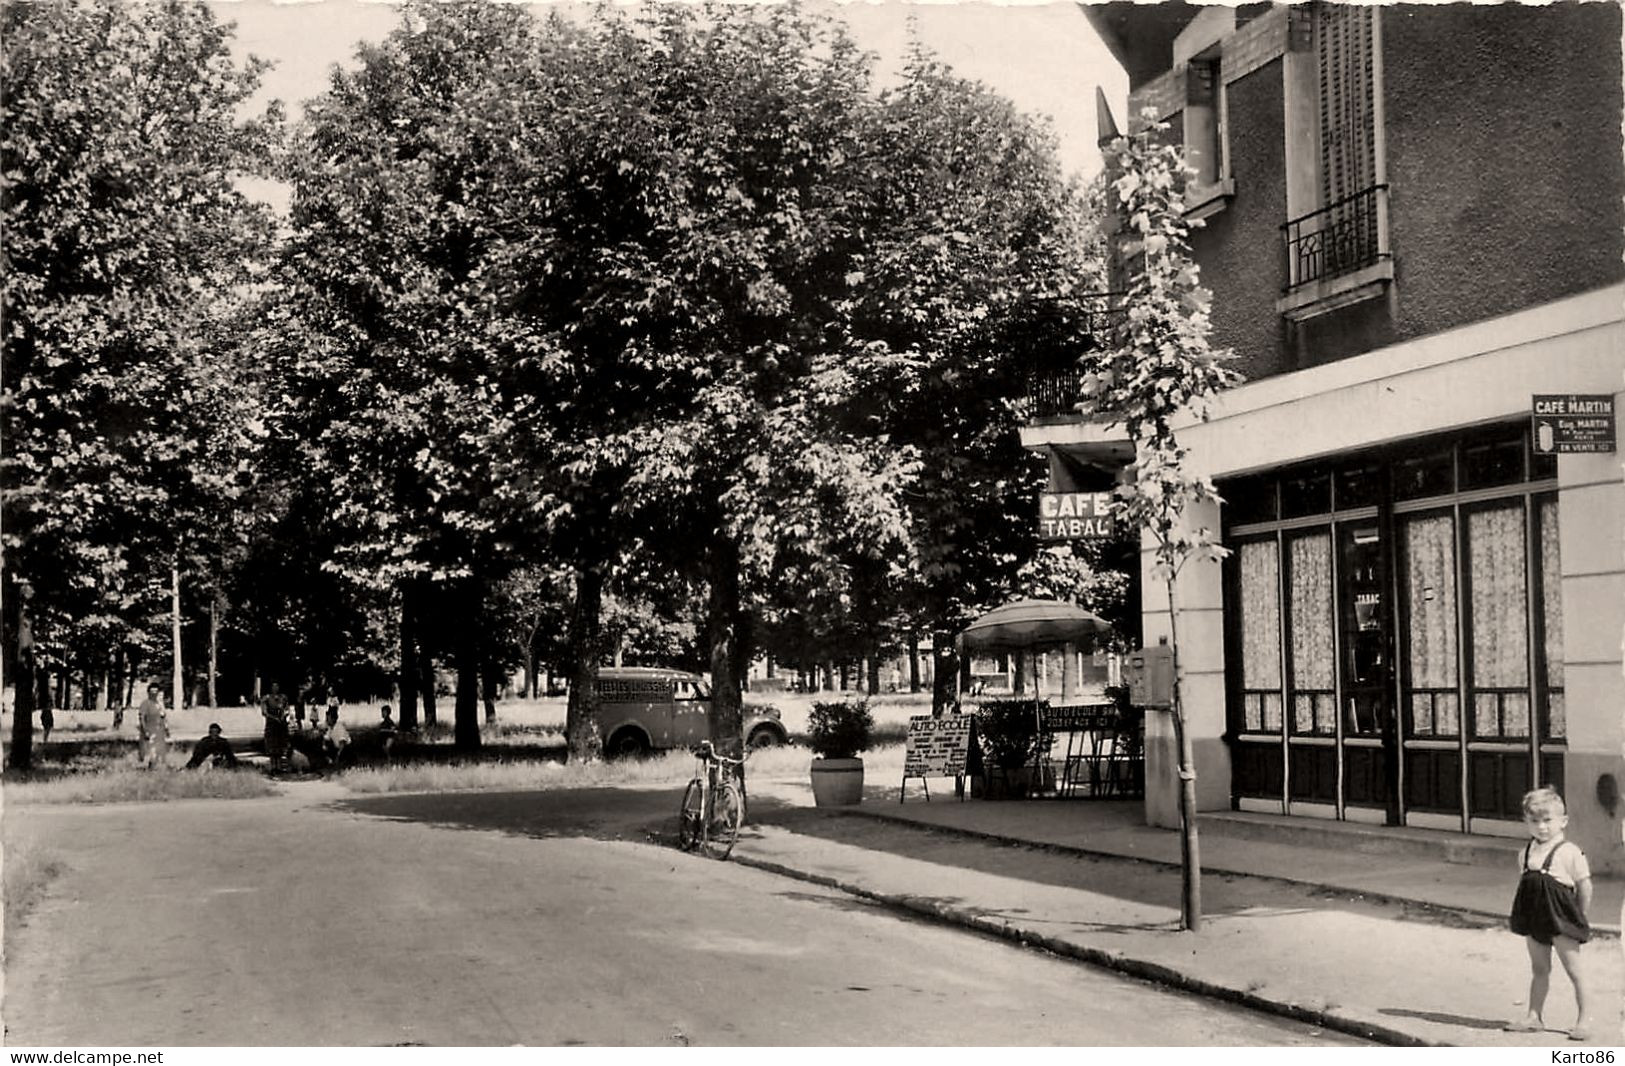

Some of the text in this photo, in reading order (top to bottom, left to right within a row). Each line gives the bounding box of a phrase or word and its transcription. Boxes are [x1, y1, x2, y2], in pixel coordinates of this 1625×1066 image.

[1568, 401, 1612, 413] MARTIN
[1577, 420, 1609, 428] MARTIN
[1042, 493, 1110, 517] CAFE
